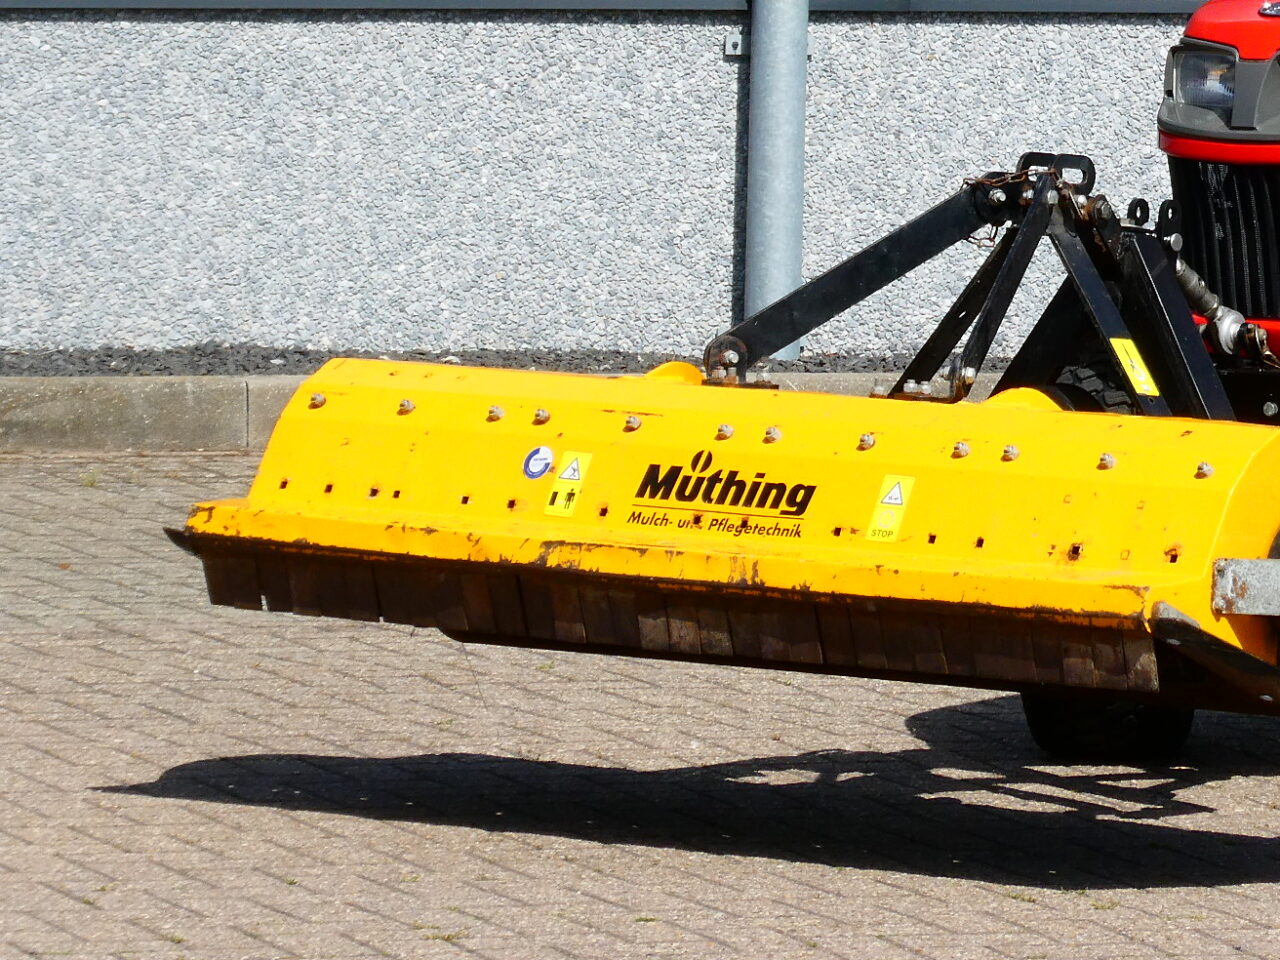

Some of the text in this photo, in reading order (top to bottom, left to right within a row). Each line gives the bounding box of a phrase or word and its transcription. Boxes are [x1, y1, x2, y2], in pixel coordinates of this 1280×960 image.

[634, 449, 817, 517] Müthing
[626, 511, 673, 527] Mulch-
[708, 518, 802, 538] Pflegetechnik
[871, 529, 894, 538] STOP
